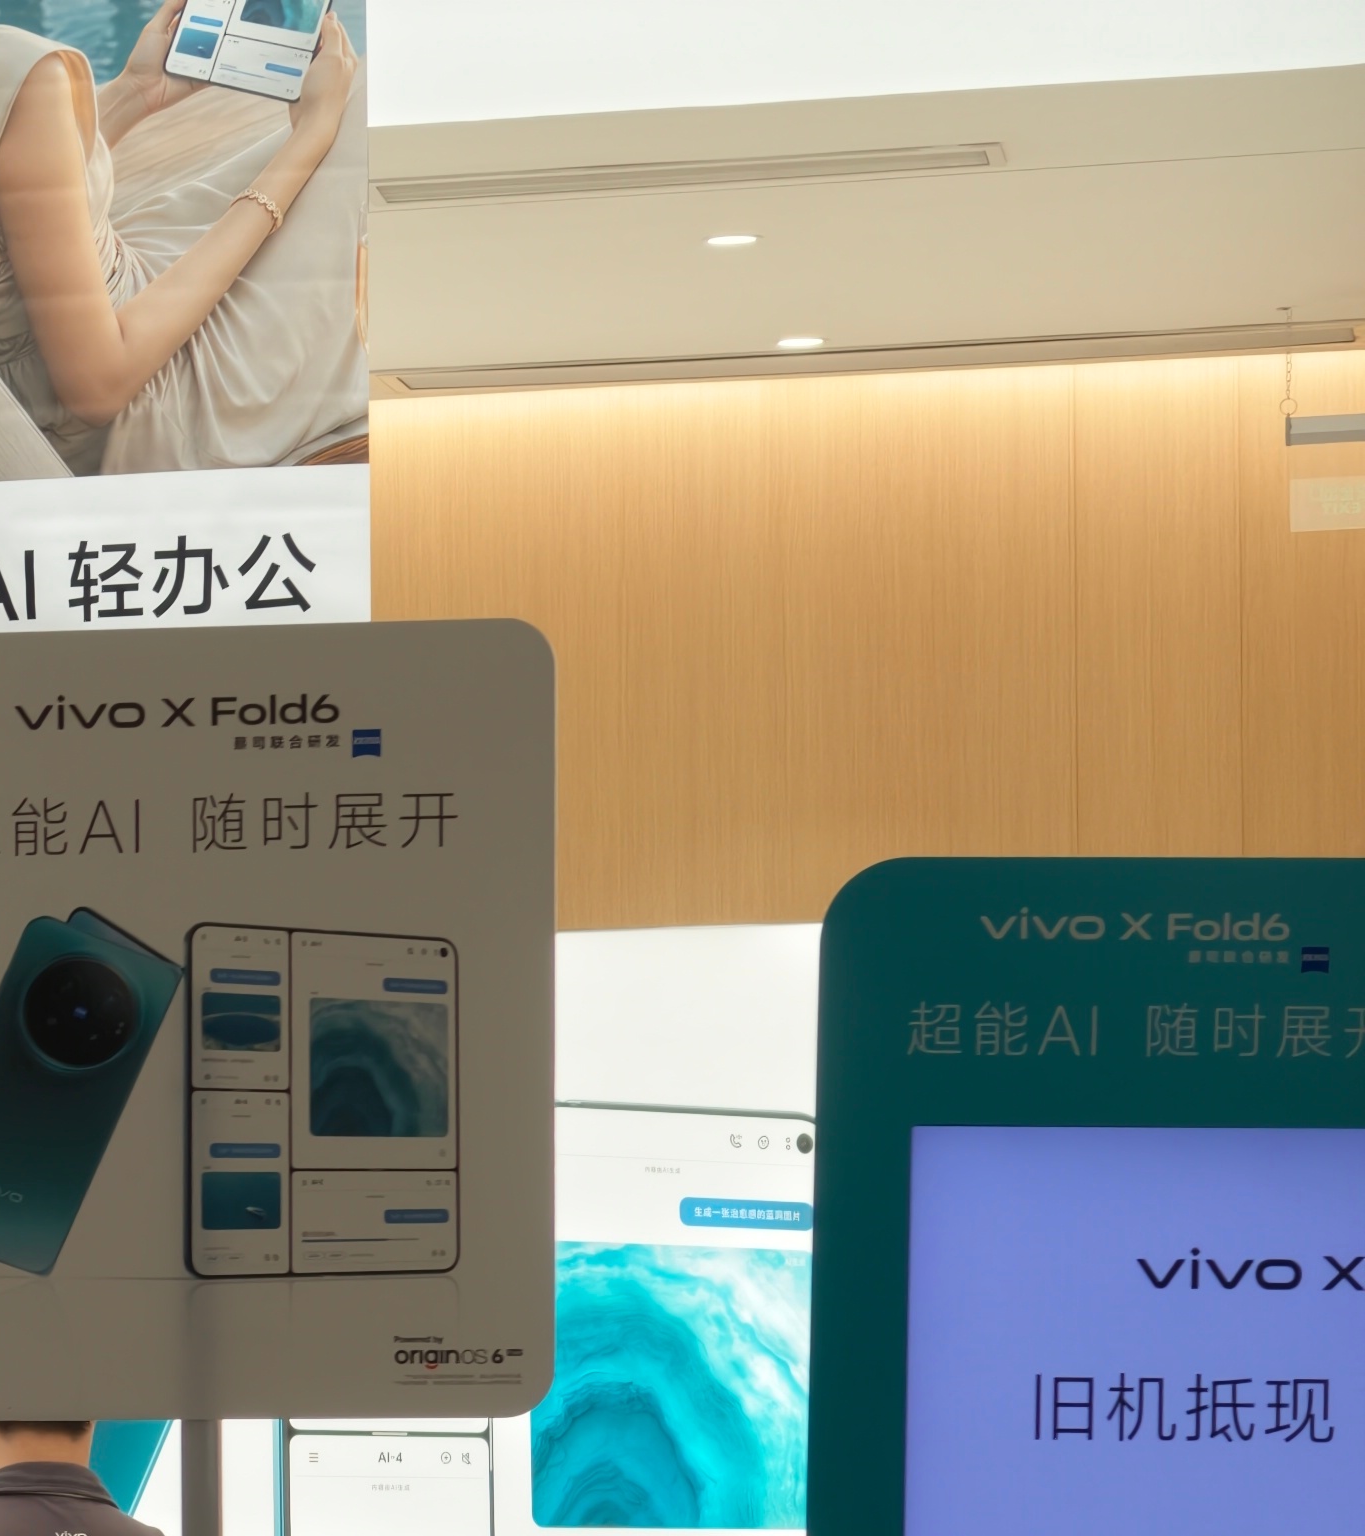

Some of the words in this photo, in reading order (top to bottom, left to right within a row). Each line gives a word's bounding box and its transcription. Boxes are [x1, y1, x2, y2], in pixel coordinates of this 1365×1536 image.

[68, 532, 316, 622] 轻办公
[15, 695, 145, 730] vivo
[161, 697, 195, 728] X
[211, 694, 340, 726] Fold6
[190, 790, 460, 854] 随时展开
[980, 907, 1106, 941] vivo
[1119, 912, 1152, 941] X
[1167, 912, 1290, 941] Fold6
[906, 1000, 1100, 1058] 超能AI
[1137, 1248, 1302, 1290] vivo
[1322, 1255, 1365, 1291] X
[1034, 1373, 1335, 1443] 旧机抵现
